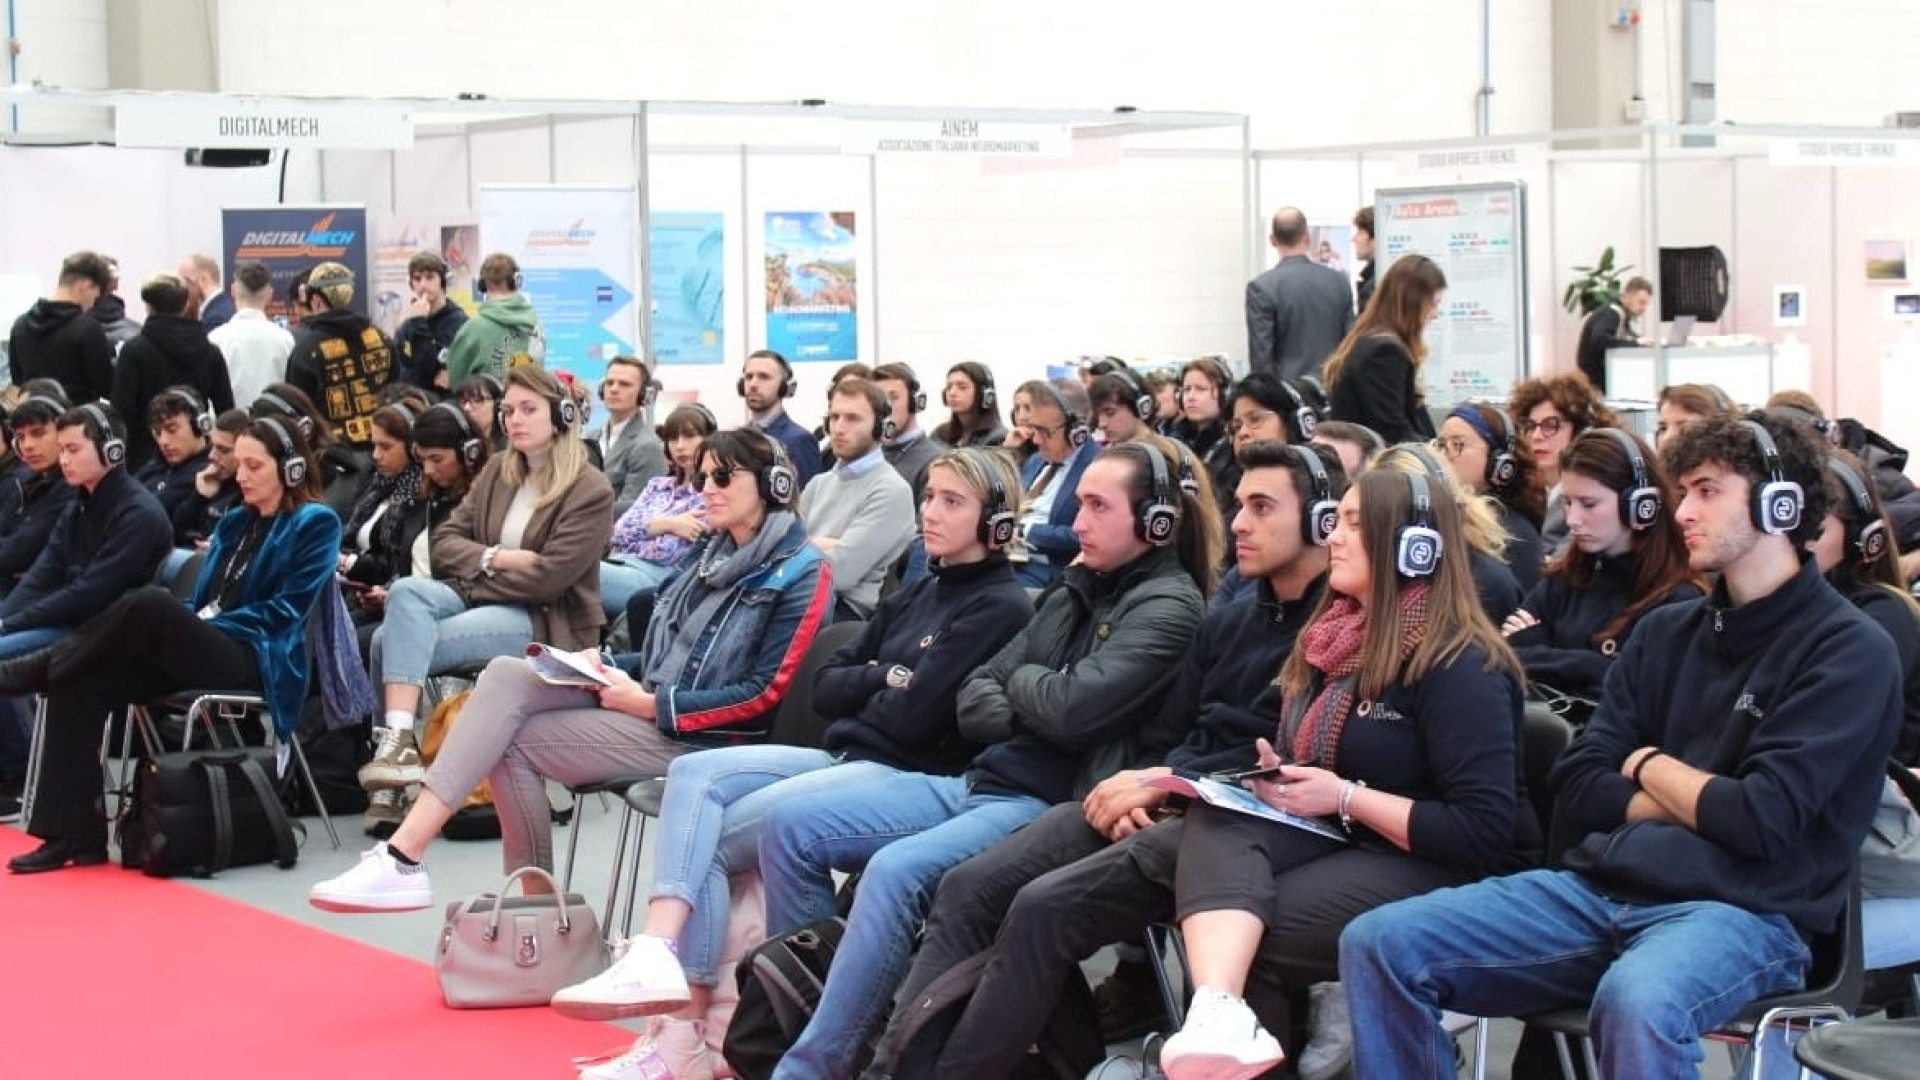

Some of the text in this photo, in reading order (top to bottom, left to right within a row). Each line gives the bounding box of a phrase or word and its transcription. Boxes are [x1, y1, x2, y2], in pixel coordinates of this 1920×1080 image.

[219, 116, 319, 137] DIGITALMECH
[940, 117, 979, 137] AINEM
[242, 230, 356, 246] DIGITALMECH
